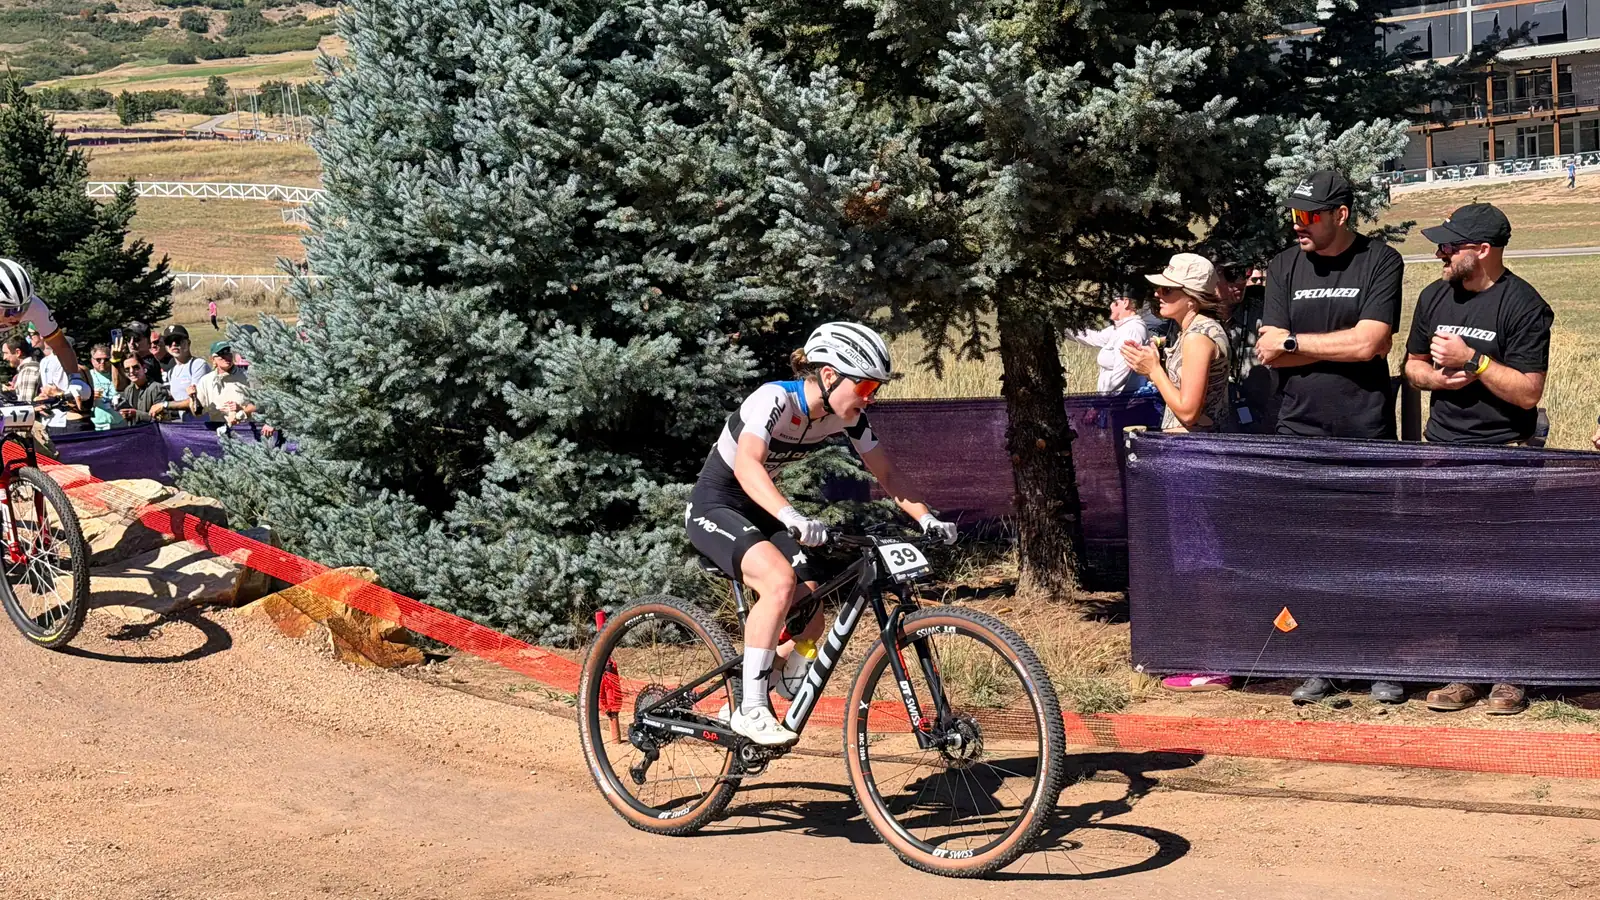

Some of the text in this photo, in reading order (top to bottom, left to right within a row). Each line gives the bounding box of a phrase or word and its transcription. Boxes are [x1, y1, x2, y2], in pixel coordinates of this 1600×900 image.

[1293, 288, 1360, 300] SPECIALIZED
[10, 410, 29, 422] 17
[890, 548, 917, 566] 39
[916, 625, 956, 638] DT SWISS
[785, 595, 865, 732] BMC
[900, 680, 920, 726] DT SWISS
[932, 848, 975, 859] DT SWISS
